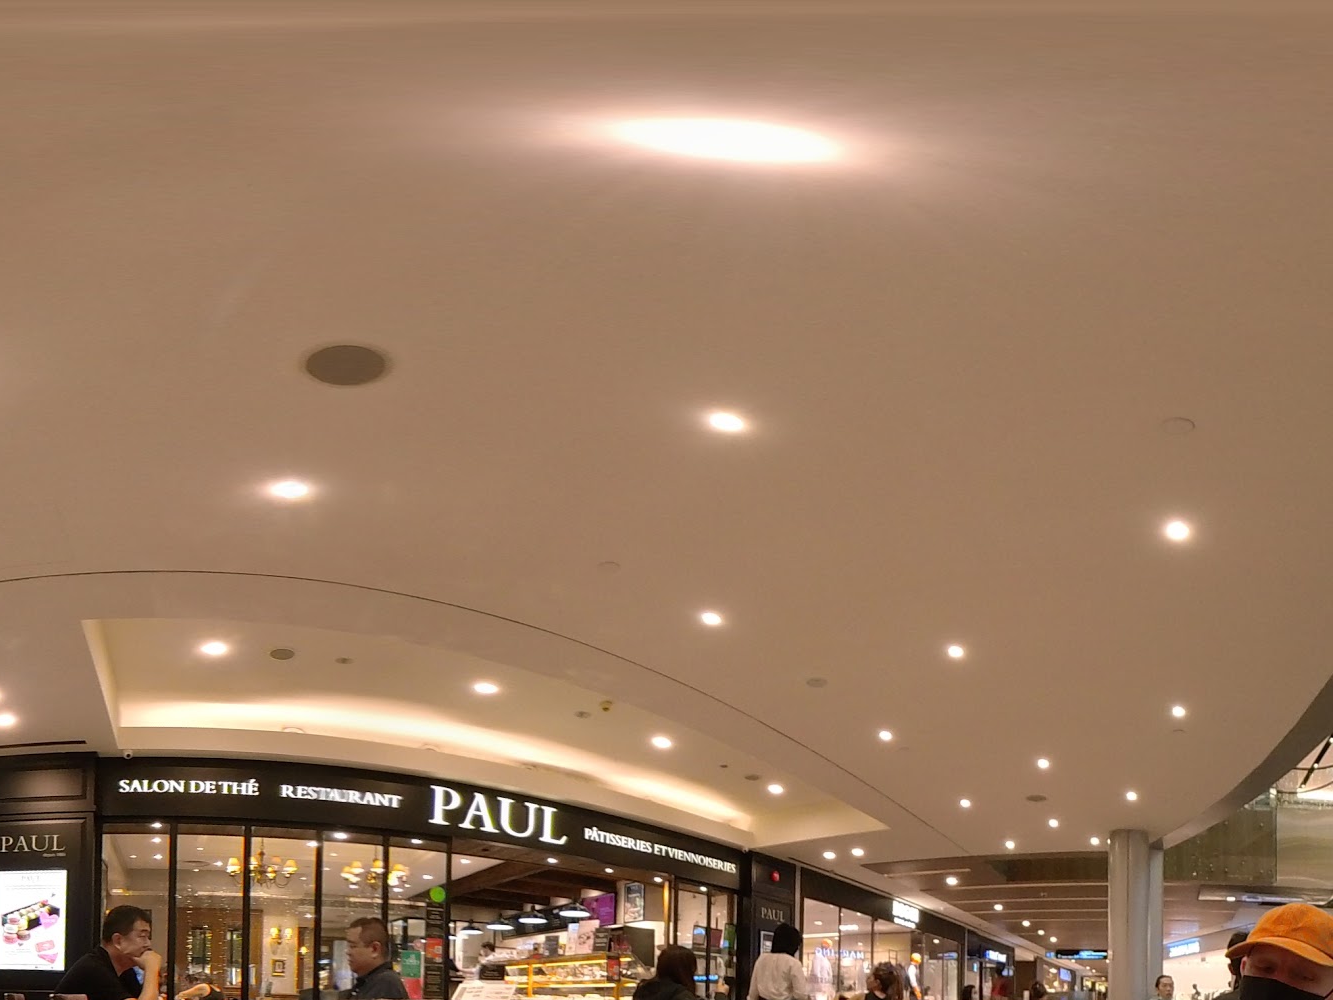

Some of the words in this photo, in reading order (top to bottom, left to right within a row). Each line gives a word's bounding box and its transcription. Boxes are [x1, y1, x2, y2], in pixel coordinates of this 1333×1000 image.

[118, 779, 185, 793] SALON
[189, 780, 216, 794] DE
[219, 778, 260, 796] THÉ
[280, 784, 403, 808] RESTAURANT
[428, 785, 568, 845] PAUL
[0, 834, 66, 852] PAUL
[583, 826, 652, 854] PÂTISSERIES
[653, 843, 667, 857] ET
[667, 847, 736, 874] VIENNOISERIES
[761, 907, 785, 922] PAUL
